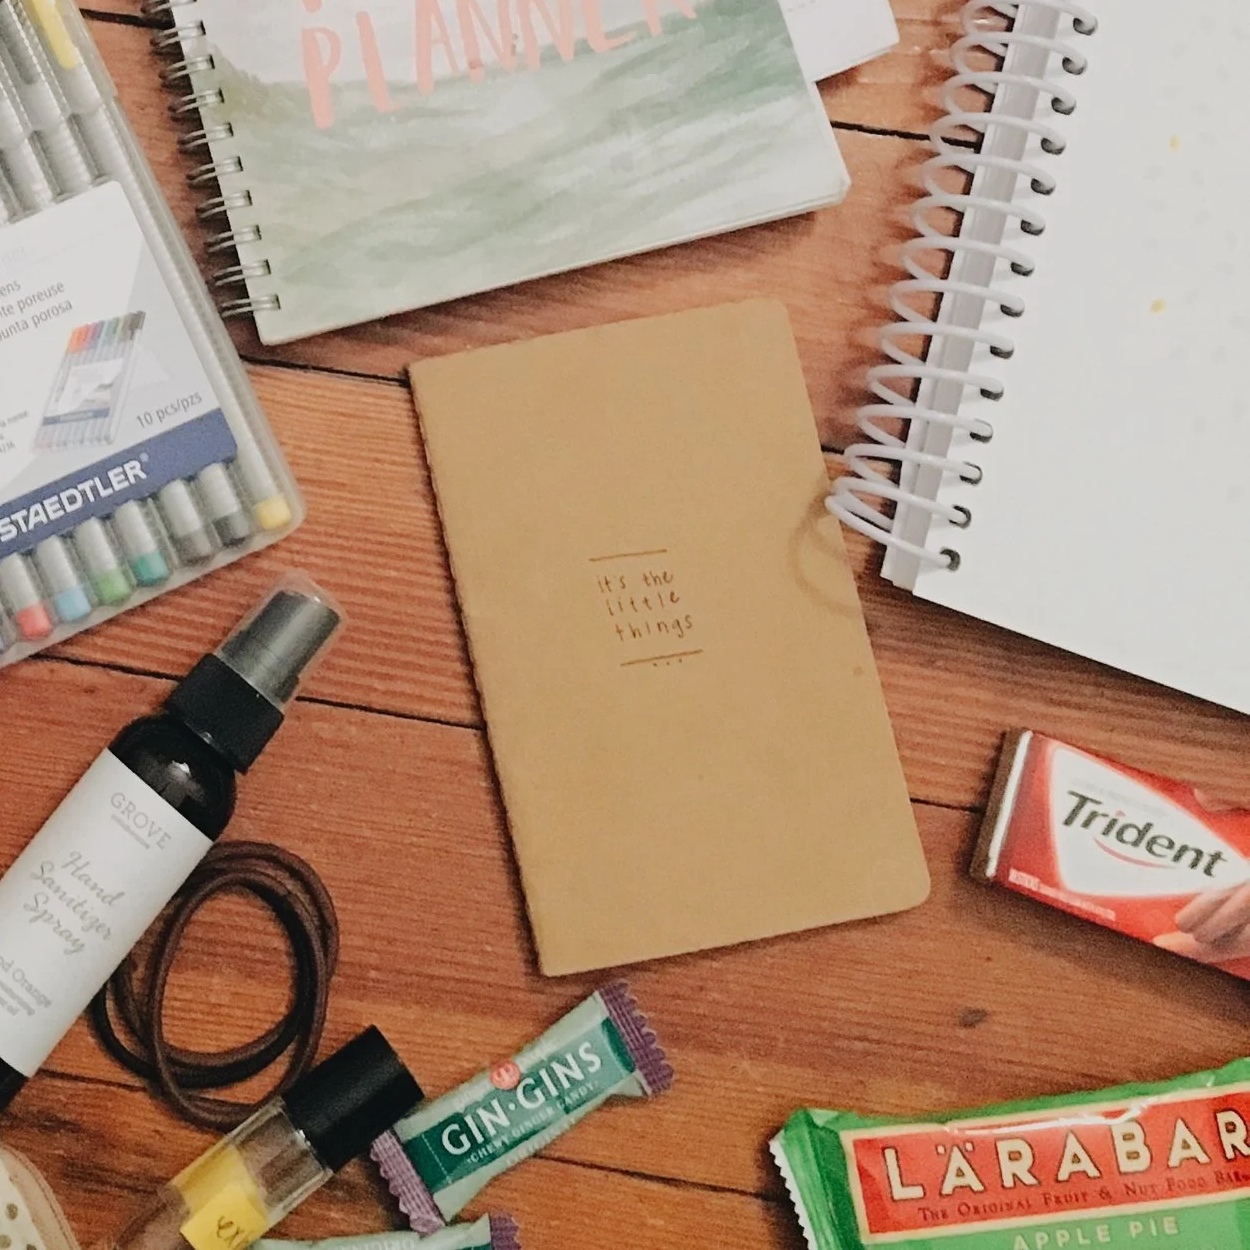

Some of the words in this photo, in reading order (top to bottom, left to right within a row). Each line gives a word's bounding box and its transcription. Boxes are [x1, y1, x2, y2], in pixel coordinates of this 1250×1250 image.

[16, 280, 66, 313] poreuse
[31, 299, 75, 327] porosa
[135, 413, 155, 430] 10
[155, 392, 203, 422] pcs/pzs
[598, 576, 626, 594] it's
[642, 570, 674, 587] the
[605, 591, 680, 617] little
[615, 614, 693, 642] things
[110, 791, 172, 850] GROVE
[1062, 790, 1229, 878] Trident
[61, 850, 125, 908] Hand
[29, 860, 111, 941] Sanitizer
[23, 892, 86, 956] Spray
[12, 968, 52, 1008] Orange
[470, 1134, 512, 1166] CHEWY
[882, 1108, 1250, 1202] LÄRABAR
[1012, 1225, 1112, 1250] APPLE
[1129, 1216, 1181, 1239] PIE
